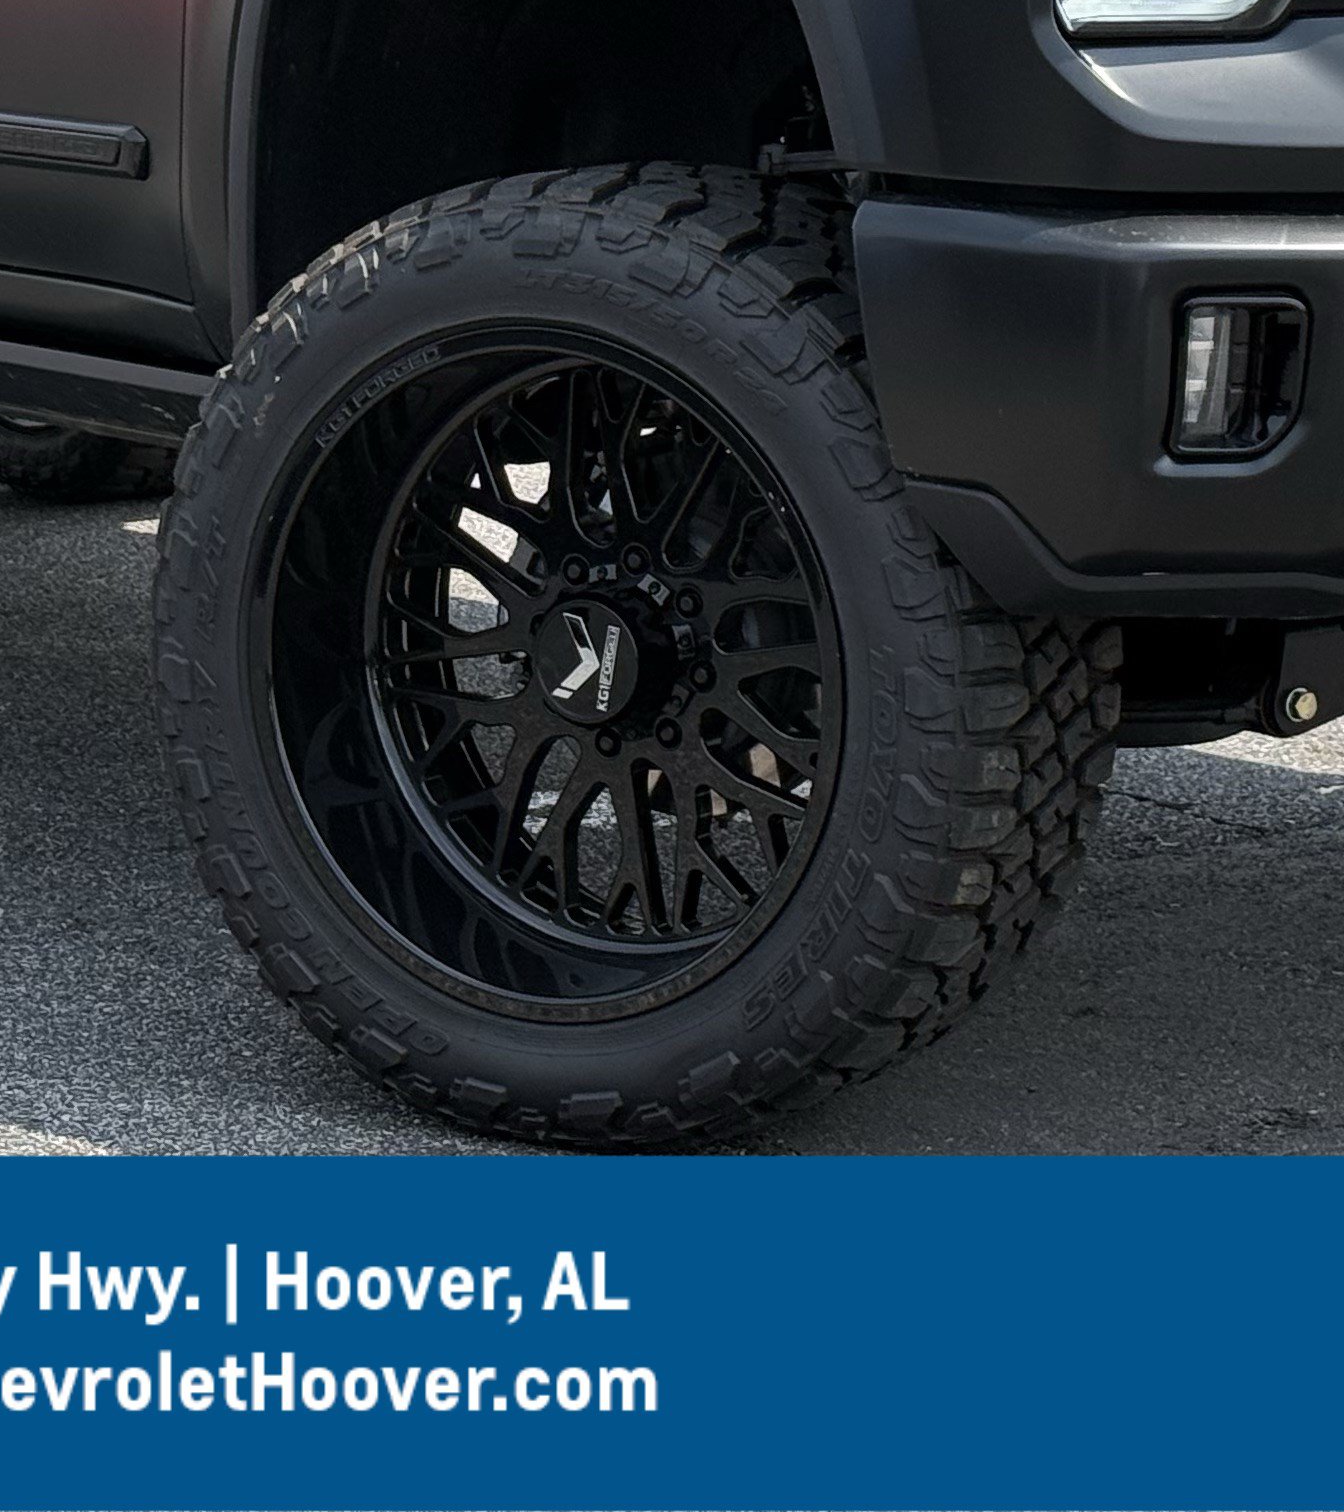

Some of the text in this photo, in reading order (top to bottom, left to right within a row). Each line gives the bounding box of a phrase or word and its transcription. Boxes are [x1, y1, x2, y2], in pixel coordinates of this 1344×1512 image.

[191, 658, 314, 942] COUNTRY
[743, 644, 897, 1031] TOYO TIRES
[314, 946, 450, 1057] OPEN
